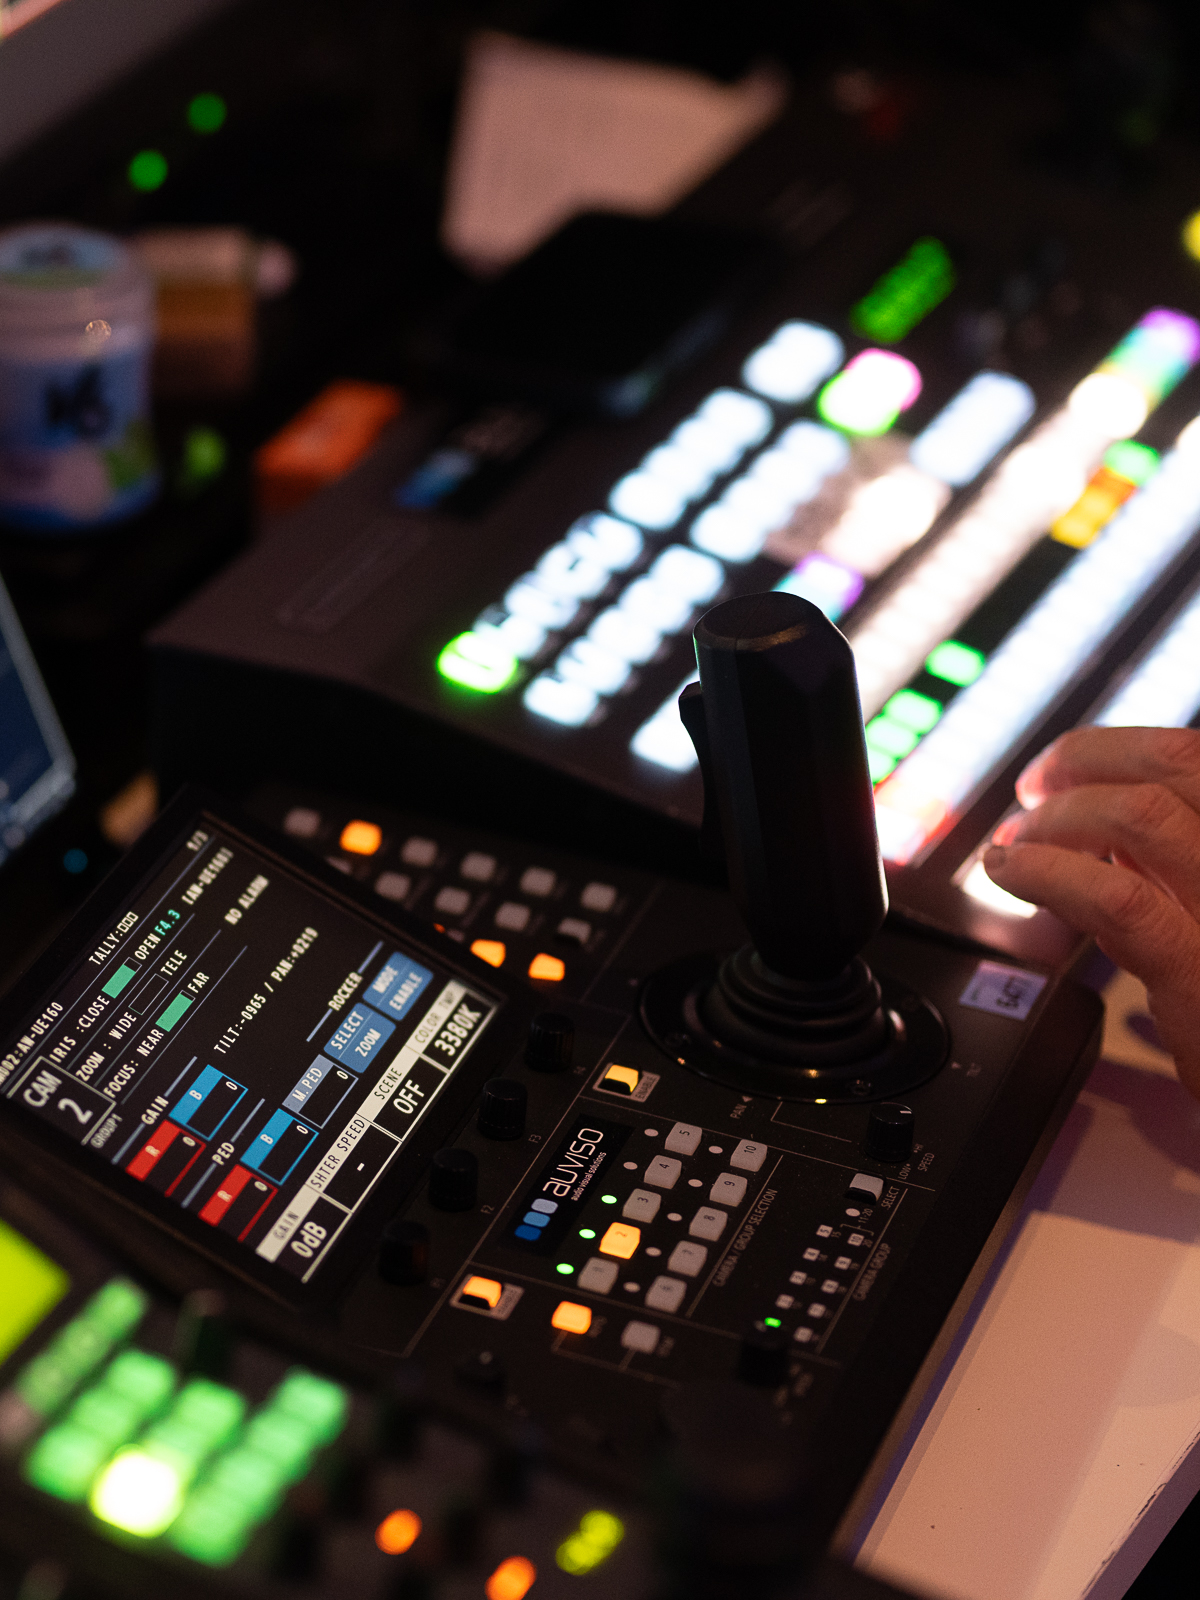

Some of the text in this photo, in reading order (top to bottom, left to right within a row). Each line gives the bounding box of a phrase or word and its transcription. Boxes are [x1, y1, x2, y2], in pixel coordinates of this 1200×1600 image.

[224, 907, 243, 926] NO
[49, 1036, 77, 1063] IRIS
[135, 933, 161, 961] OPEN
[154, 908, 181, 936] F4.3
[328, 971, 364, 1012] ROCKER
[389, 971, 424, 1012] ENABLE
[75, 1051, 105, 1082] ZOOM
[109, 1011, 138, 1040] WIDE
[160, 949, 188, 976] TELE
[136, 1028, 165, 1058] NEAR
[187, 971, 210, 994] FAR
[213, 992, 267, 1054] TILT:-0965
[414, 1011, 442, 1045] COLOR
[434, 1002, 483, 1056] 3380K
[331, 1010, 365, 1050] SELECT
[355, 1028, 382, 1058] ZOOM
[23, 1070, 63, 1108] CAM
[225, 1080, 238, 1091] 0
[292, 1066, 324, 1102] M.PED
[336, 1069, 349, 1080] 0
[374, 1067, 404, 1101] SCENE
[141, 1095, 170, 1125] GAIN
[188, 1089, 203, 1101] B
[393, 1079, 425, 1114] OFF
[57, 1097, 94, 1125] 2
[729, 1102, 748, 1120] PAN
[182, 1136, 196, 1147] 0
[259, 1133, 274, 1145] B
[296, 1124, 309, 1135] 0
[528, 1132, 542, 1144] F3
[211, 1142, 235, 1166] PED
[310, 1117, 367, 1189] SHTER SPEED
[743, 1145, 757, 1154] 10
[917, 1152, 936, 1173] SPEED
[571, 1151, 607, 1201] audio visual solutions
[659, 1162, 670, 1170] 4
[897, 1166, 912, 1181] LOW
[480, 1204, 495, 1215] F2
[880, 1185, 901, 1211] SELECT
[272, 1209, 300, 1243] GAIN
[733, 1222, 757, 1254] GROUP
[750, 1187, 779, 1228] SELECTION
[290, 1220, 328, 1259] 0dB
